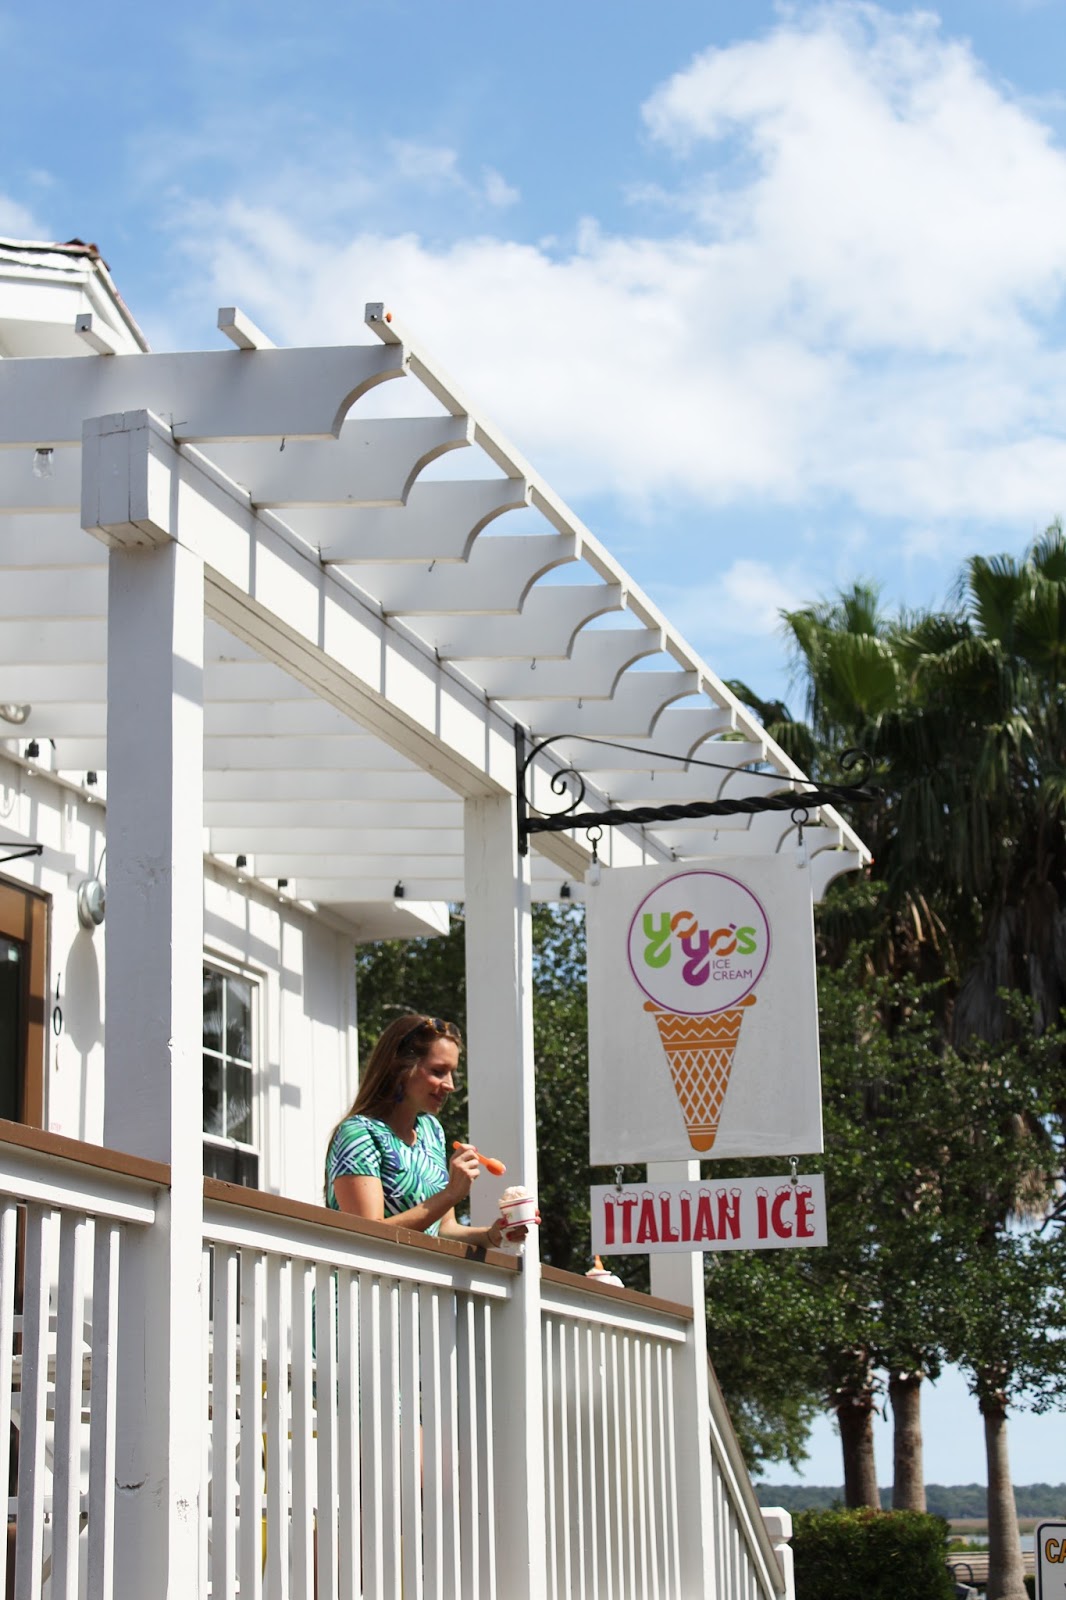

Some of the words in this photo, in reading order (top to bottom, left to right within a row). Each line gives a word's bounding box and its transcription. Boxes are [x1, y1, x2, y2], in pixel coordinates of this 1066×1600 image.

[712, 959, 731, 969] ICE
[712, 969, 753, 981] CREAM
[603, 1187, 741, 1245] ITALIAN
[755, 1184, 815, 1239] ICE
